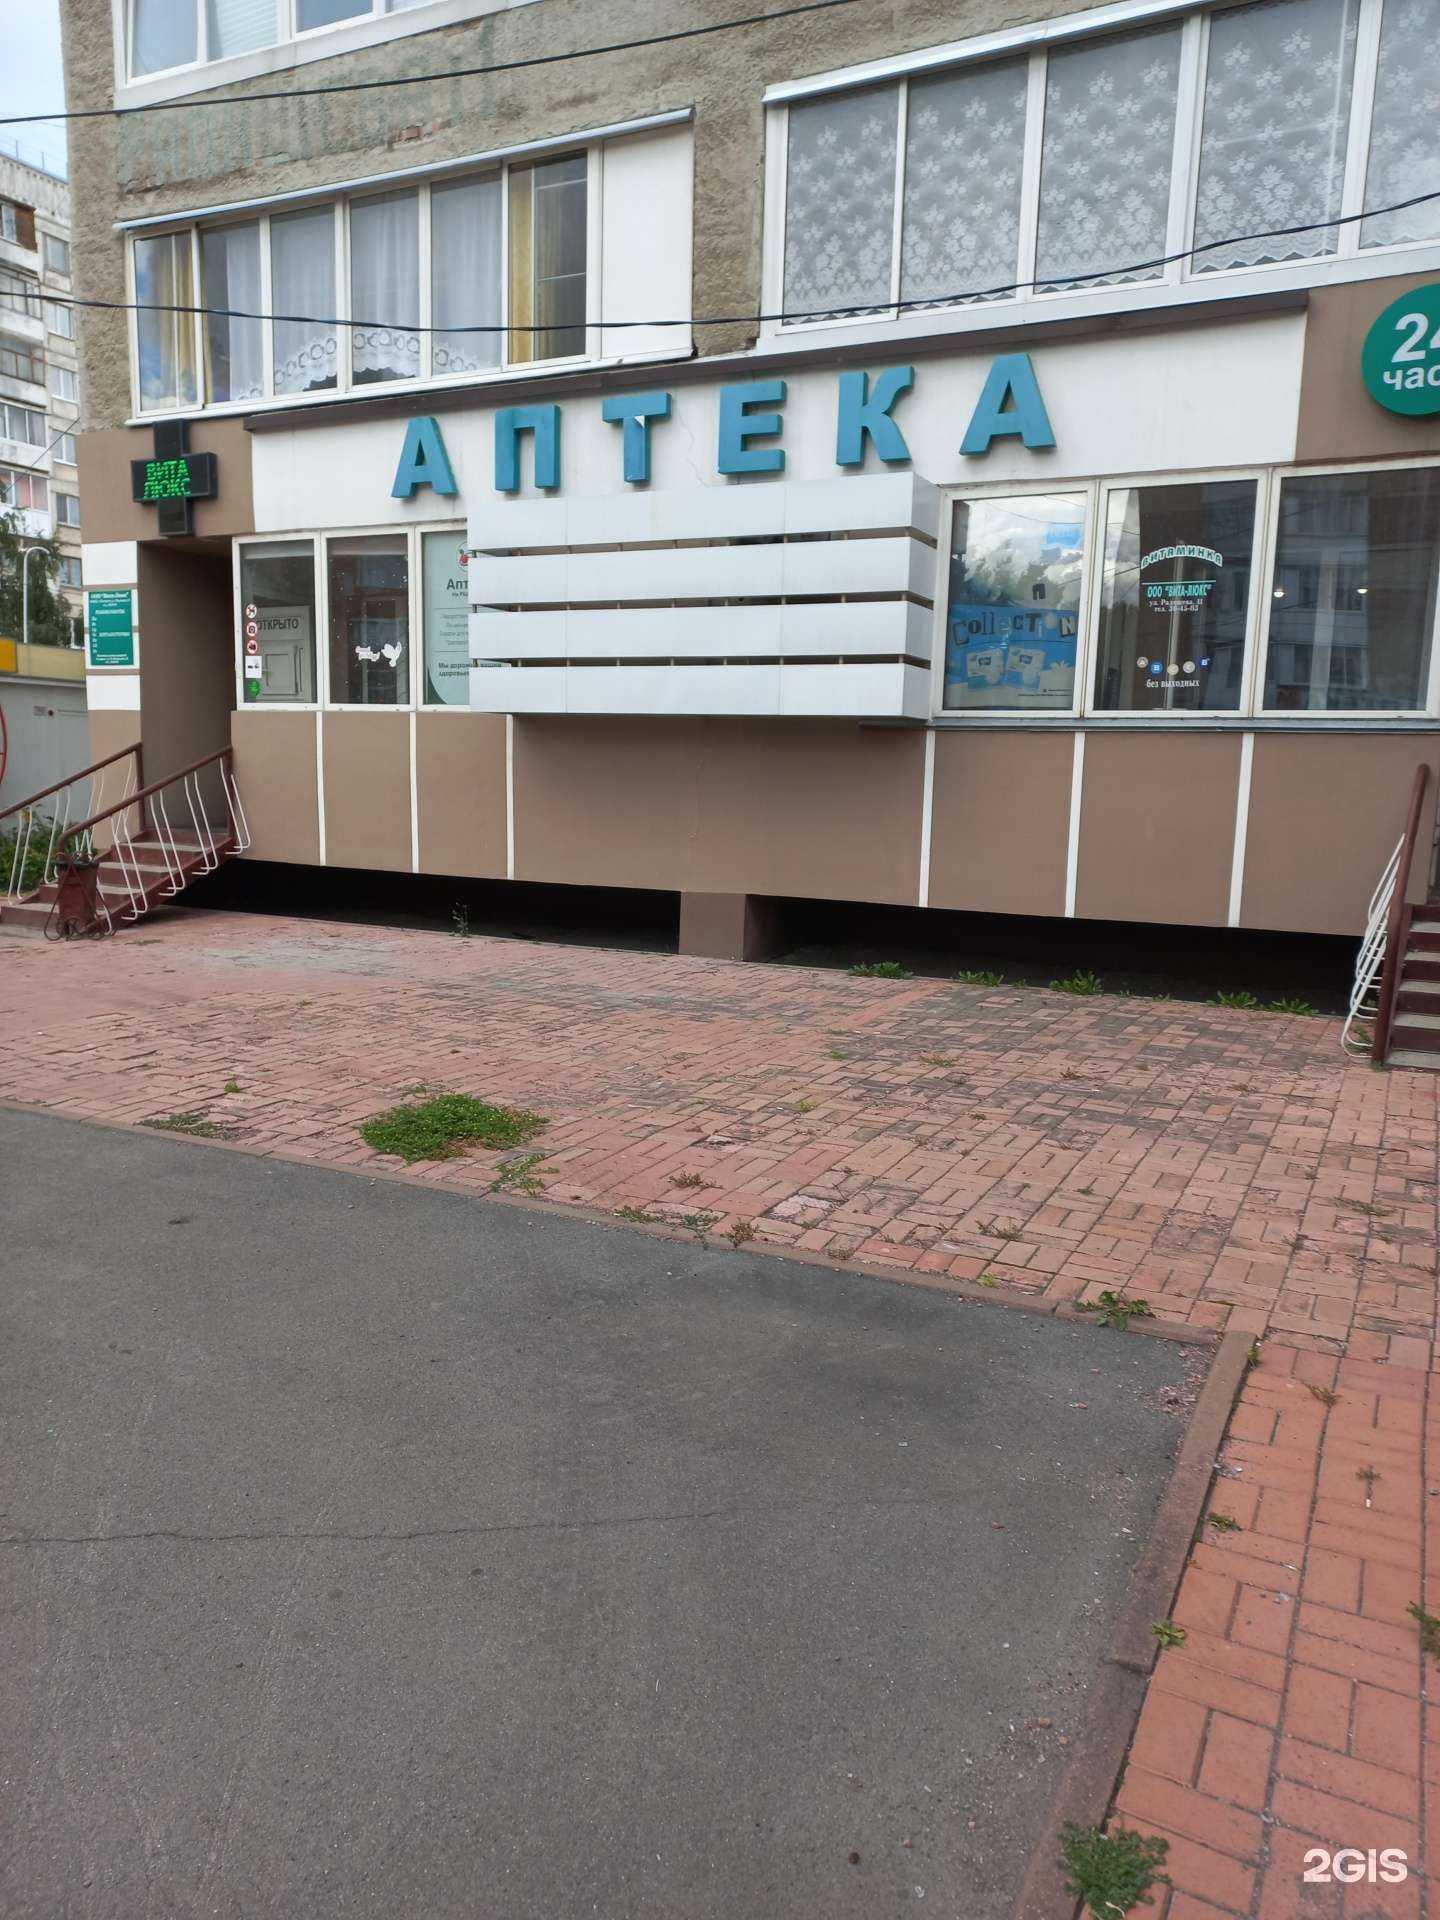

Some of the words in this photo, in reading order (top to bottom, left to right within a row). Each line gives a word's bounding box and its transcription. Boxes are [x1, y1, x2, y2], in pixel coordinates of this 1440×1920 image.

[1391, 312, 1440, 363] 2
[393, 355, 1054, 497] АПТЕКА
[1147, 586, 1163, 598] ООО
